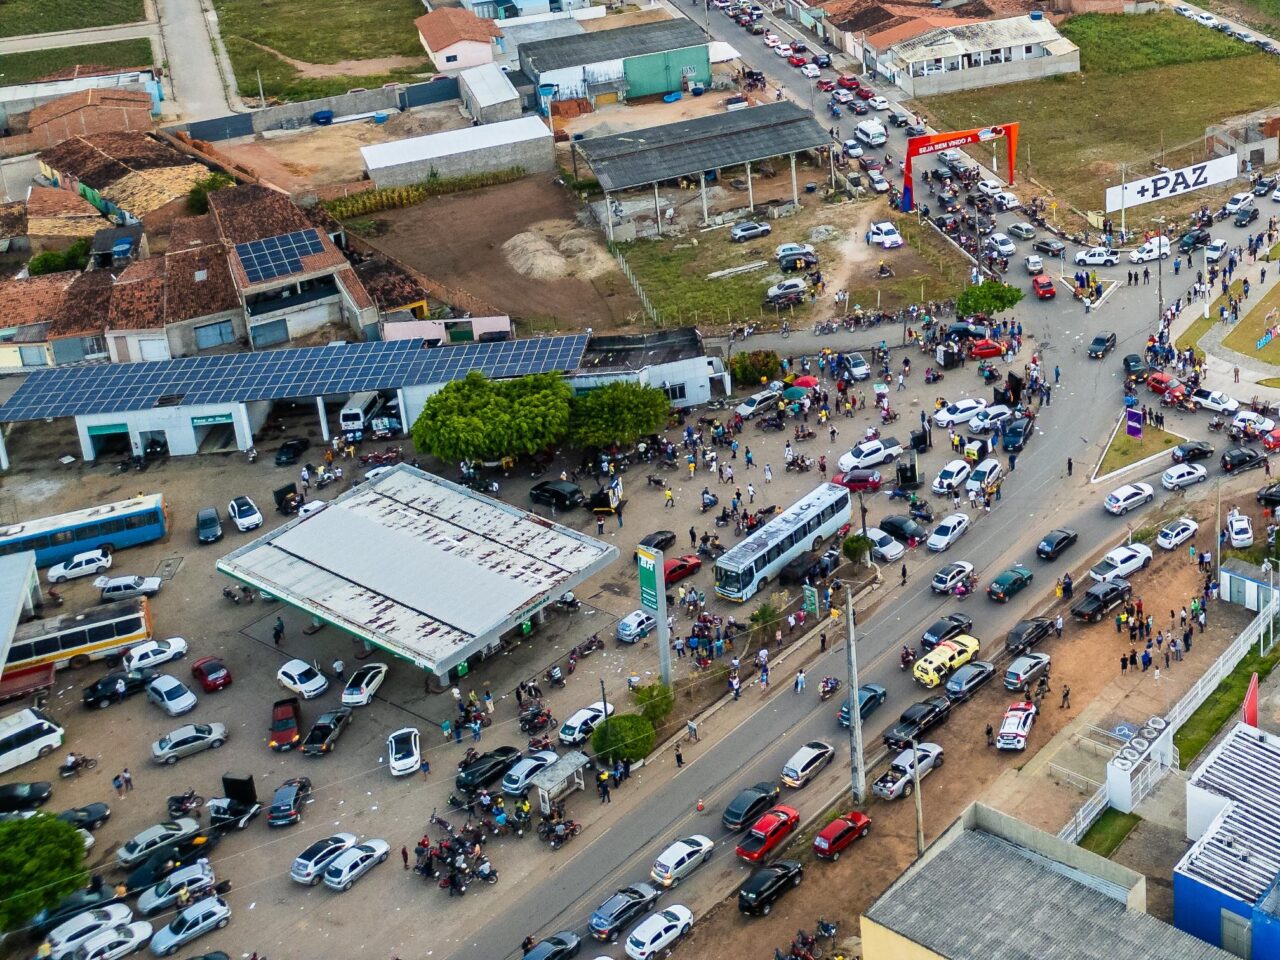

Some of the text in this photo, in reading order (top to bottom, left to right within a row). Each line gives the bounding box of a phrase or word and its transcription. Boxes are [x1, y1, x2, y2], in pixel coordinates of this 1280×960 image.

[918, 145, 934, 154] SEJA
[934, 142, 948, 150] BEM
[948, 138, 966, 147] VINDO
